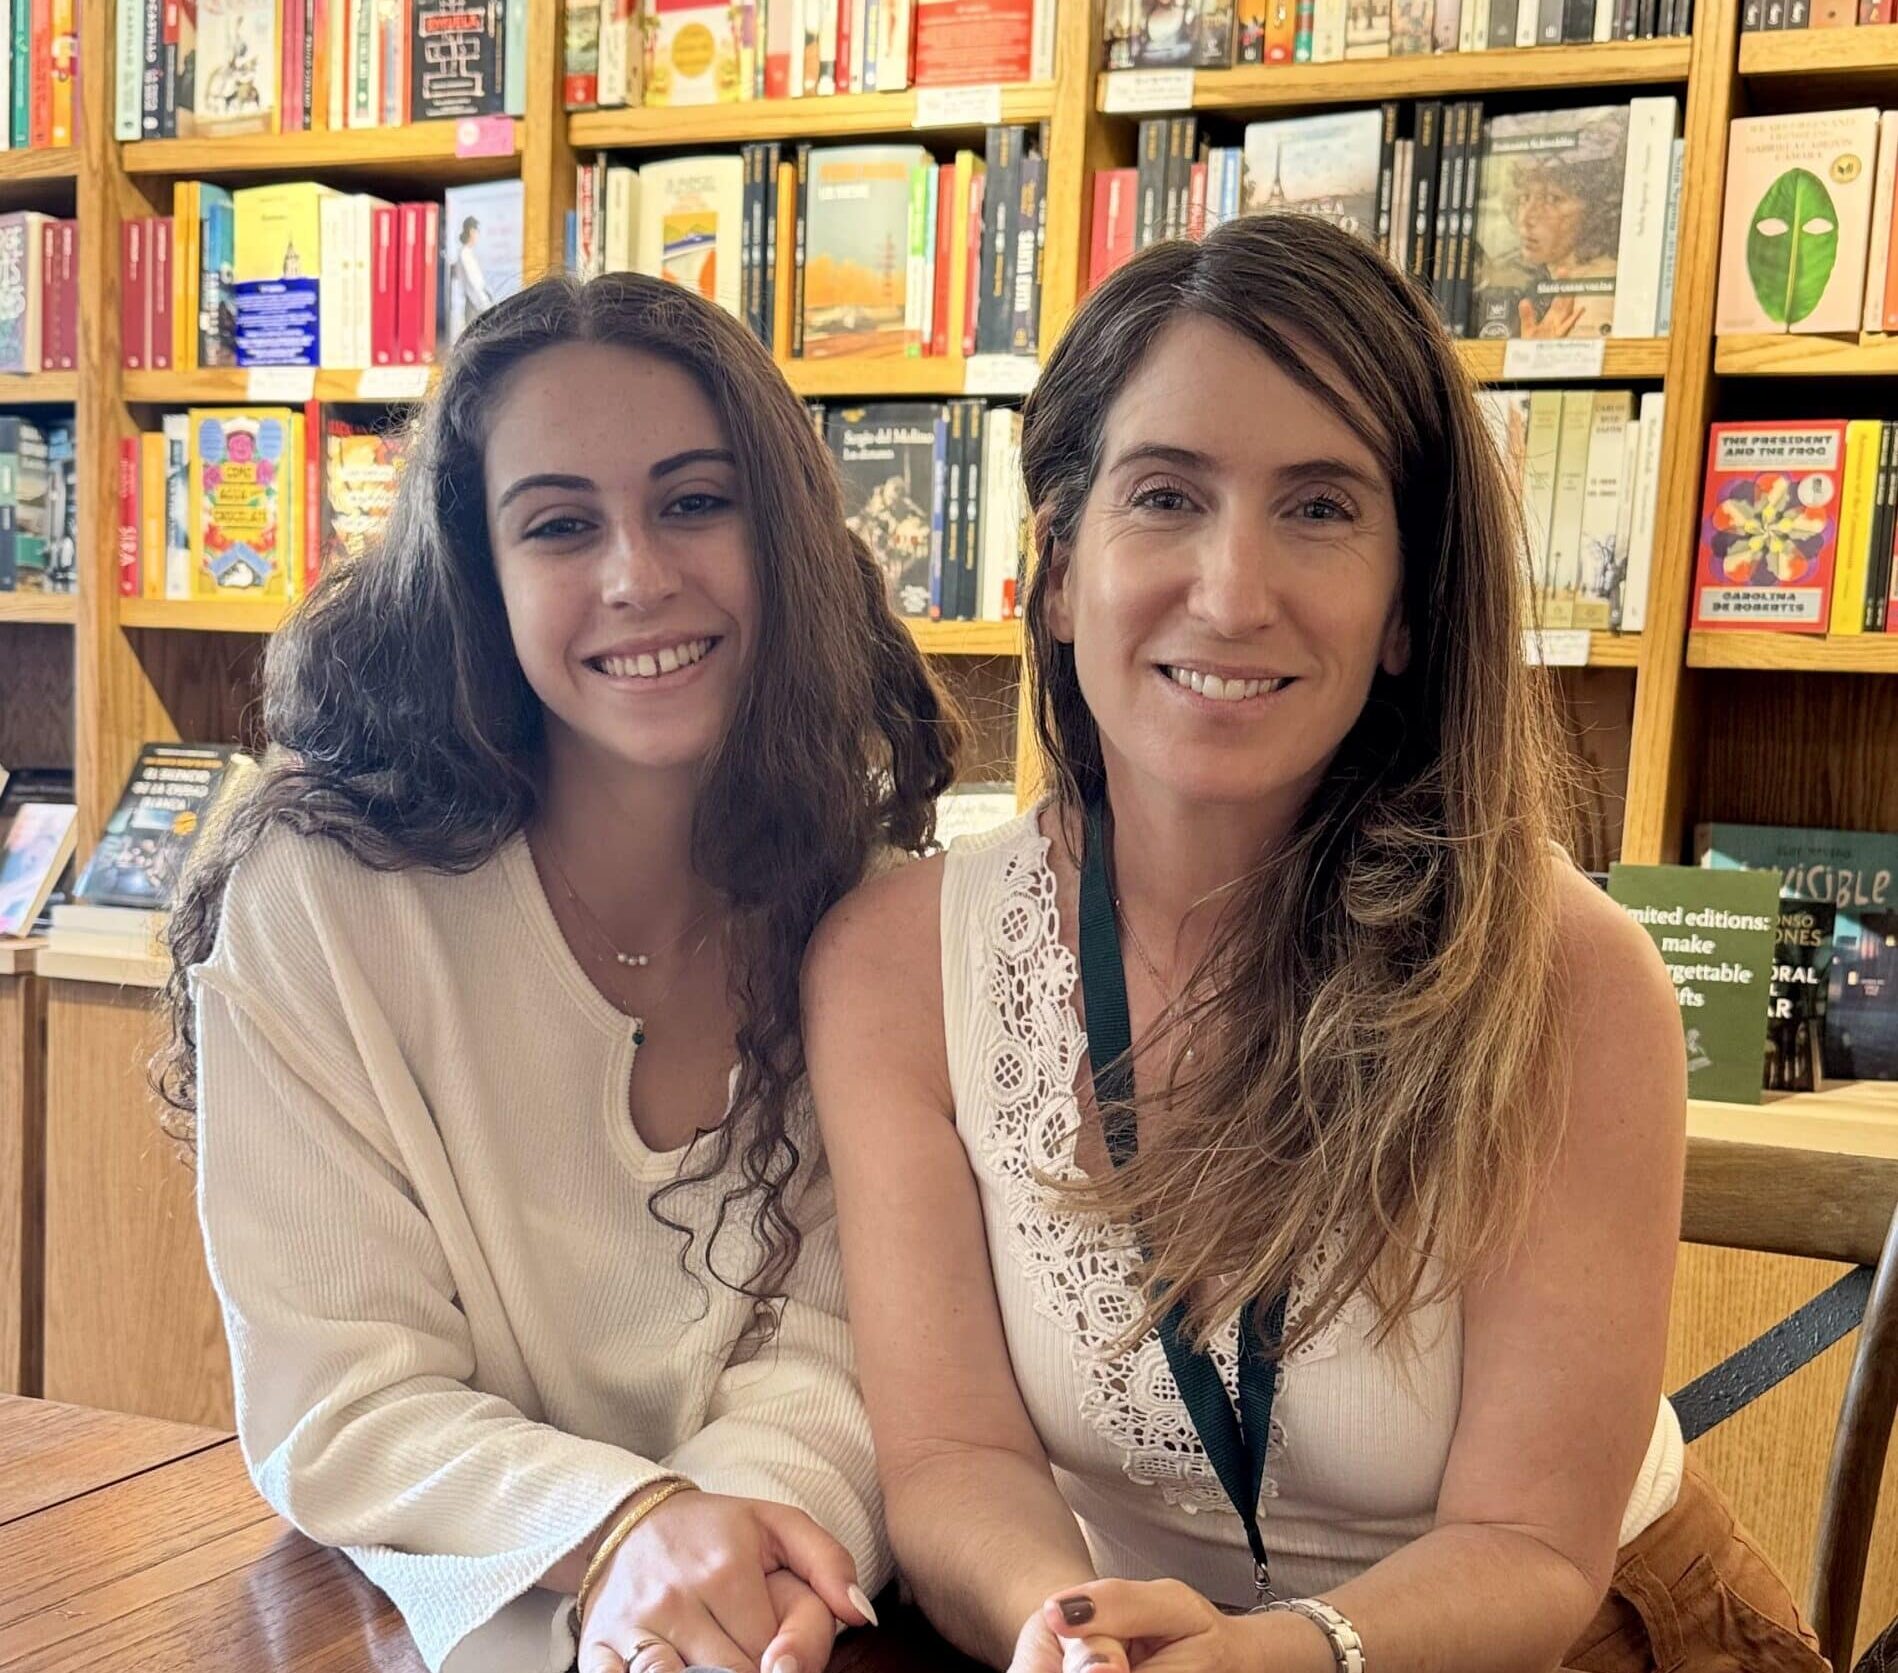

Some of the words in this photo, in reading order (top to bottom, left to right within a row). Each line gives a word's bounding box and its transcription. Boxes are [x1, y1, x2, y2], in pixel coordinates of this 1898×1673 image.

[1722, 436, 1747, 445] THE
[1752, 435, 1832, 445] PRESIDENT
[1724, 447, 1755, 456] AND
[1759, 447, 1784, 457] THE
[1788, 446, 1826, 456] FROG
[1722, 591, 1796, 601] CAROLINA
[1712, 602, 1730, 612] DE
[1733, 603, 1804, 613] ROBERTIS
[1622, 904, 1684, 926] mited
[1685, 907, 1771, 931] editions:
[1776, 914, 1814, 927] NSO
[1661, 934, 1716, 954] make
[1775, 929, 1822, 947] ONES
[1665, 963, 1753, 984] rgettable
[1770, 964, 1818, 984] ORAL
[1675, 986, 1705, 1008] fts
